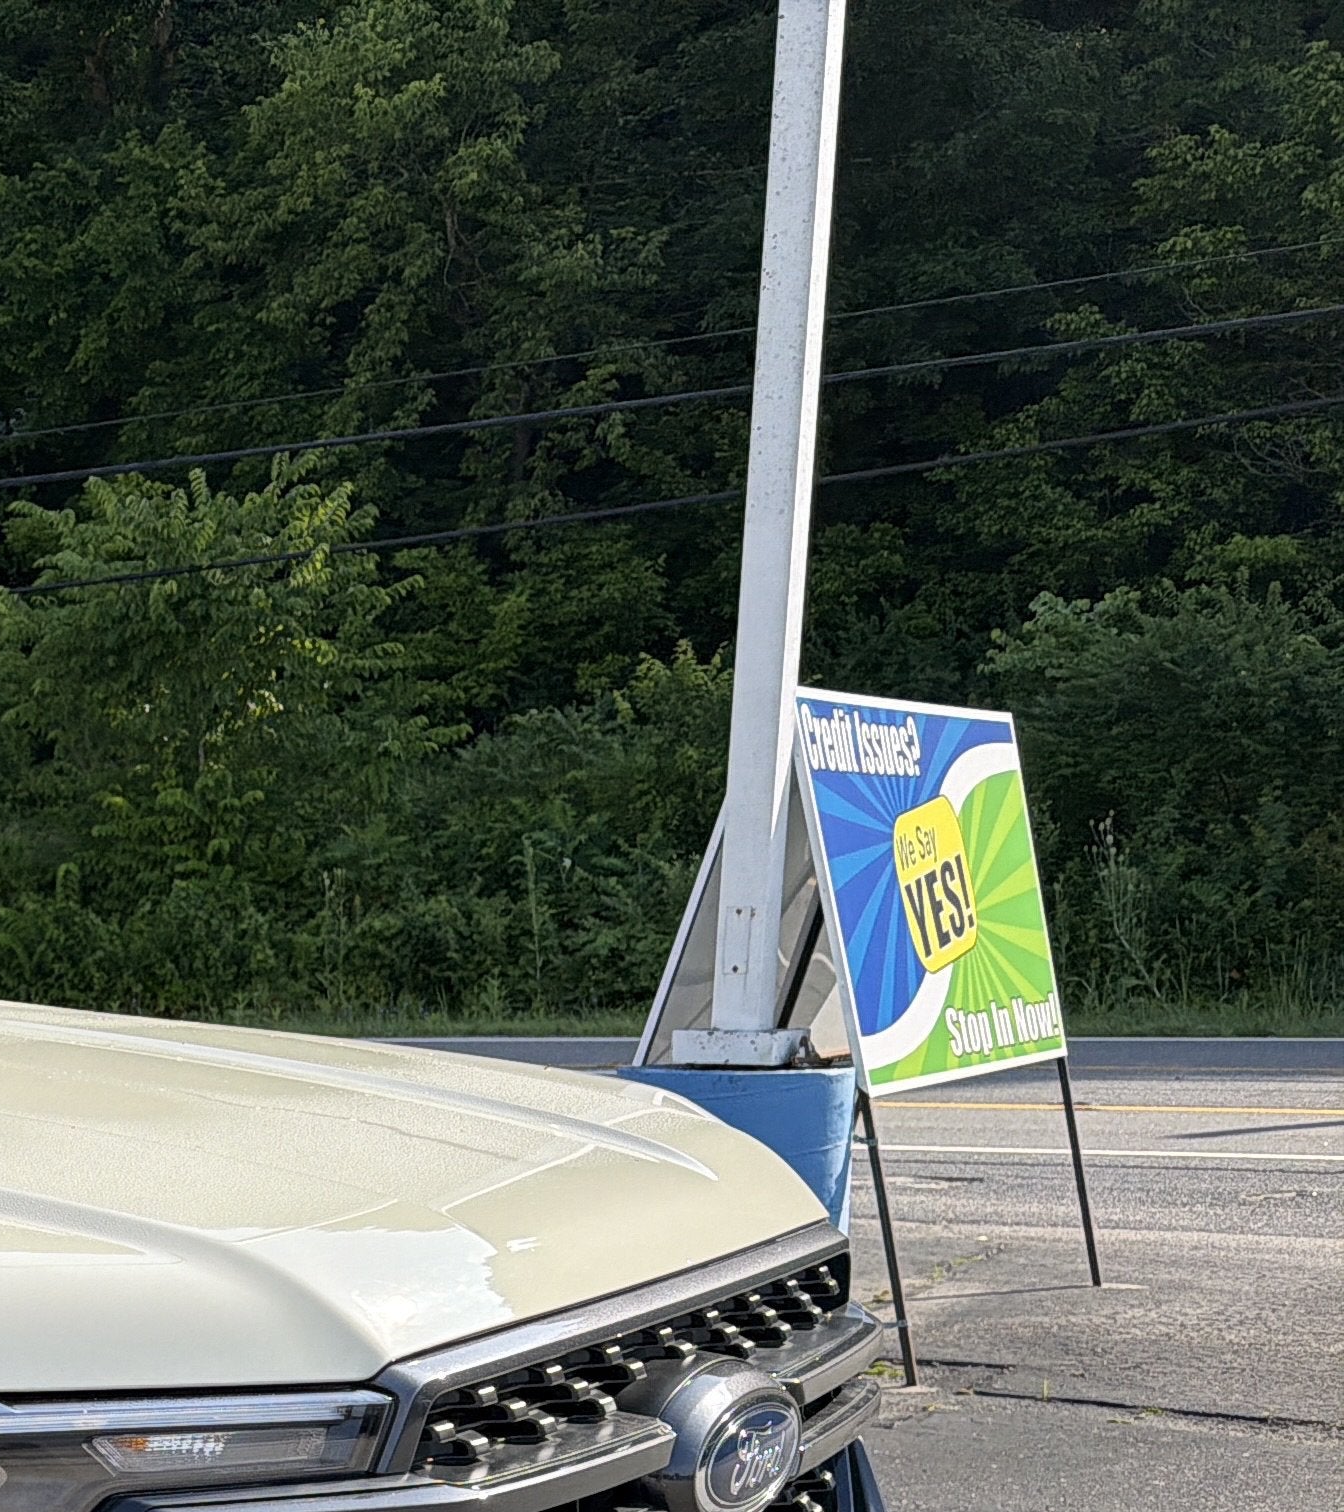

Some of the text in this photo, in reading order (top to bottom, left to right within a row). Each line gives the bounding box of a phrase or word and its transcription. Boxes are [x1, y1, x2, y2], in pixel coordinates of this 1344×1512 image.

[800, 703, 921, 777] Credit Issues?
[896, 825, 938, 871] We Say
[904, 853, 975, 959] YES!
[945, 991, 1061, 1058] Stop In Now!
[730, 1420, 787, 1496] Ford
